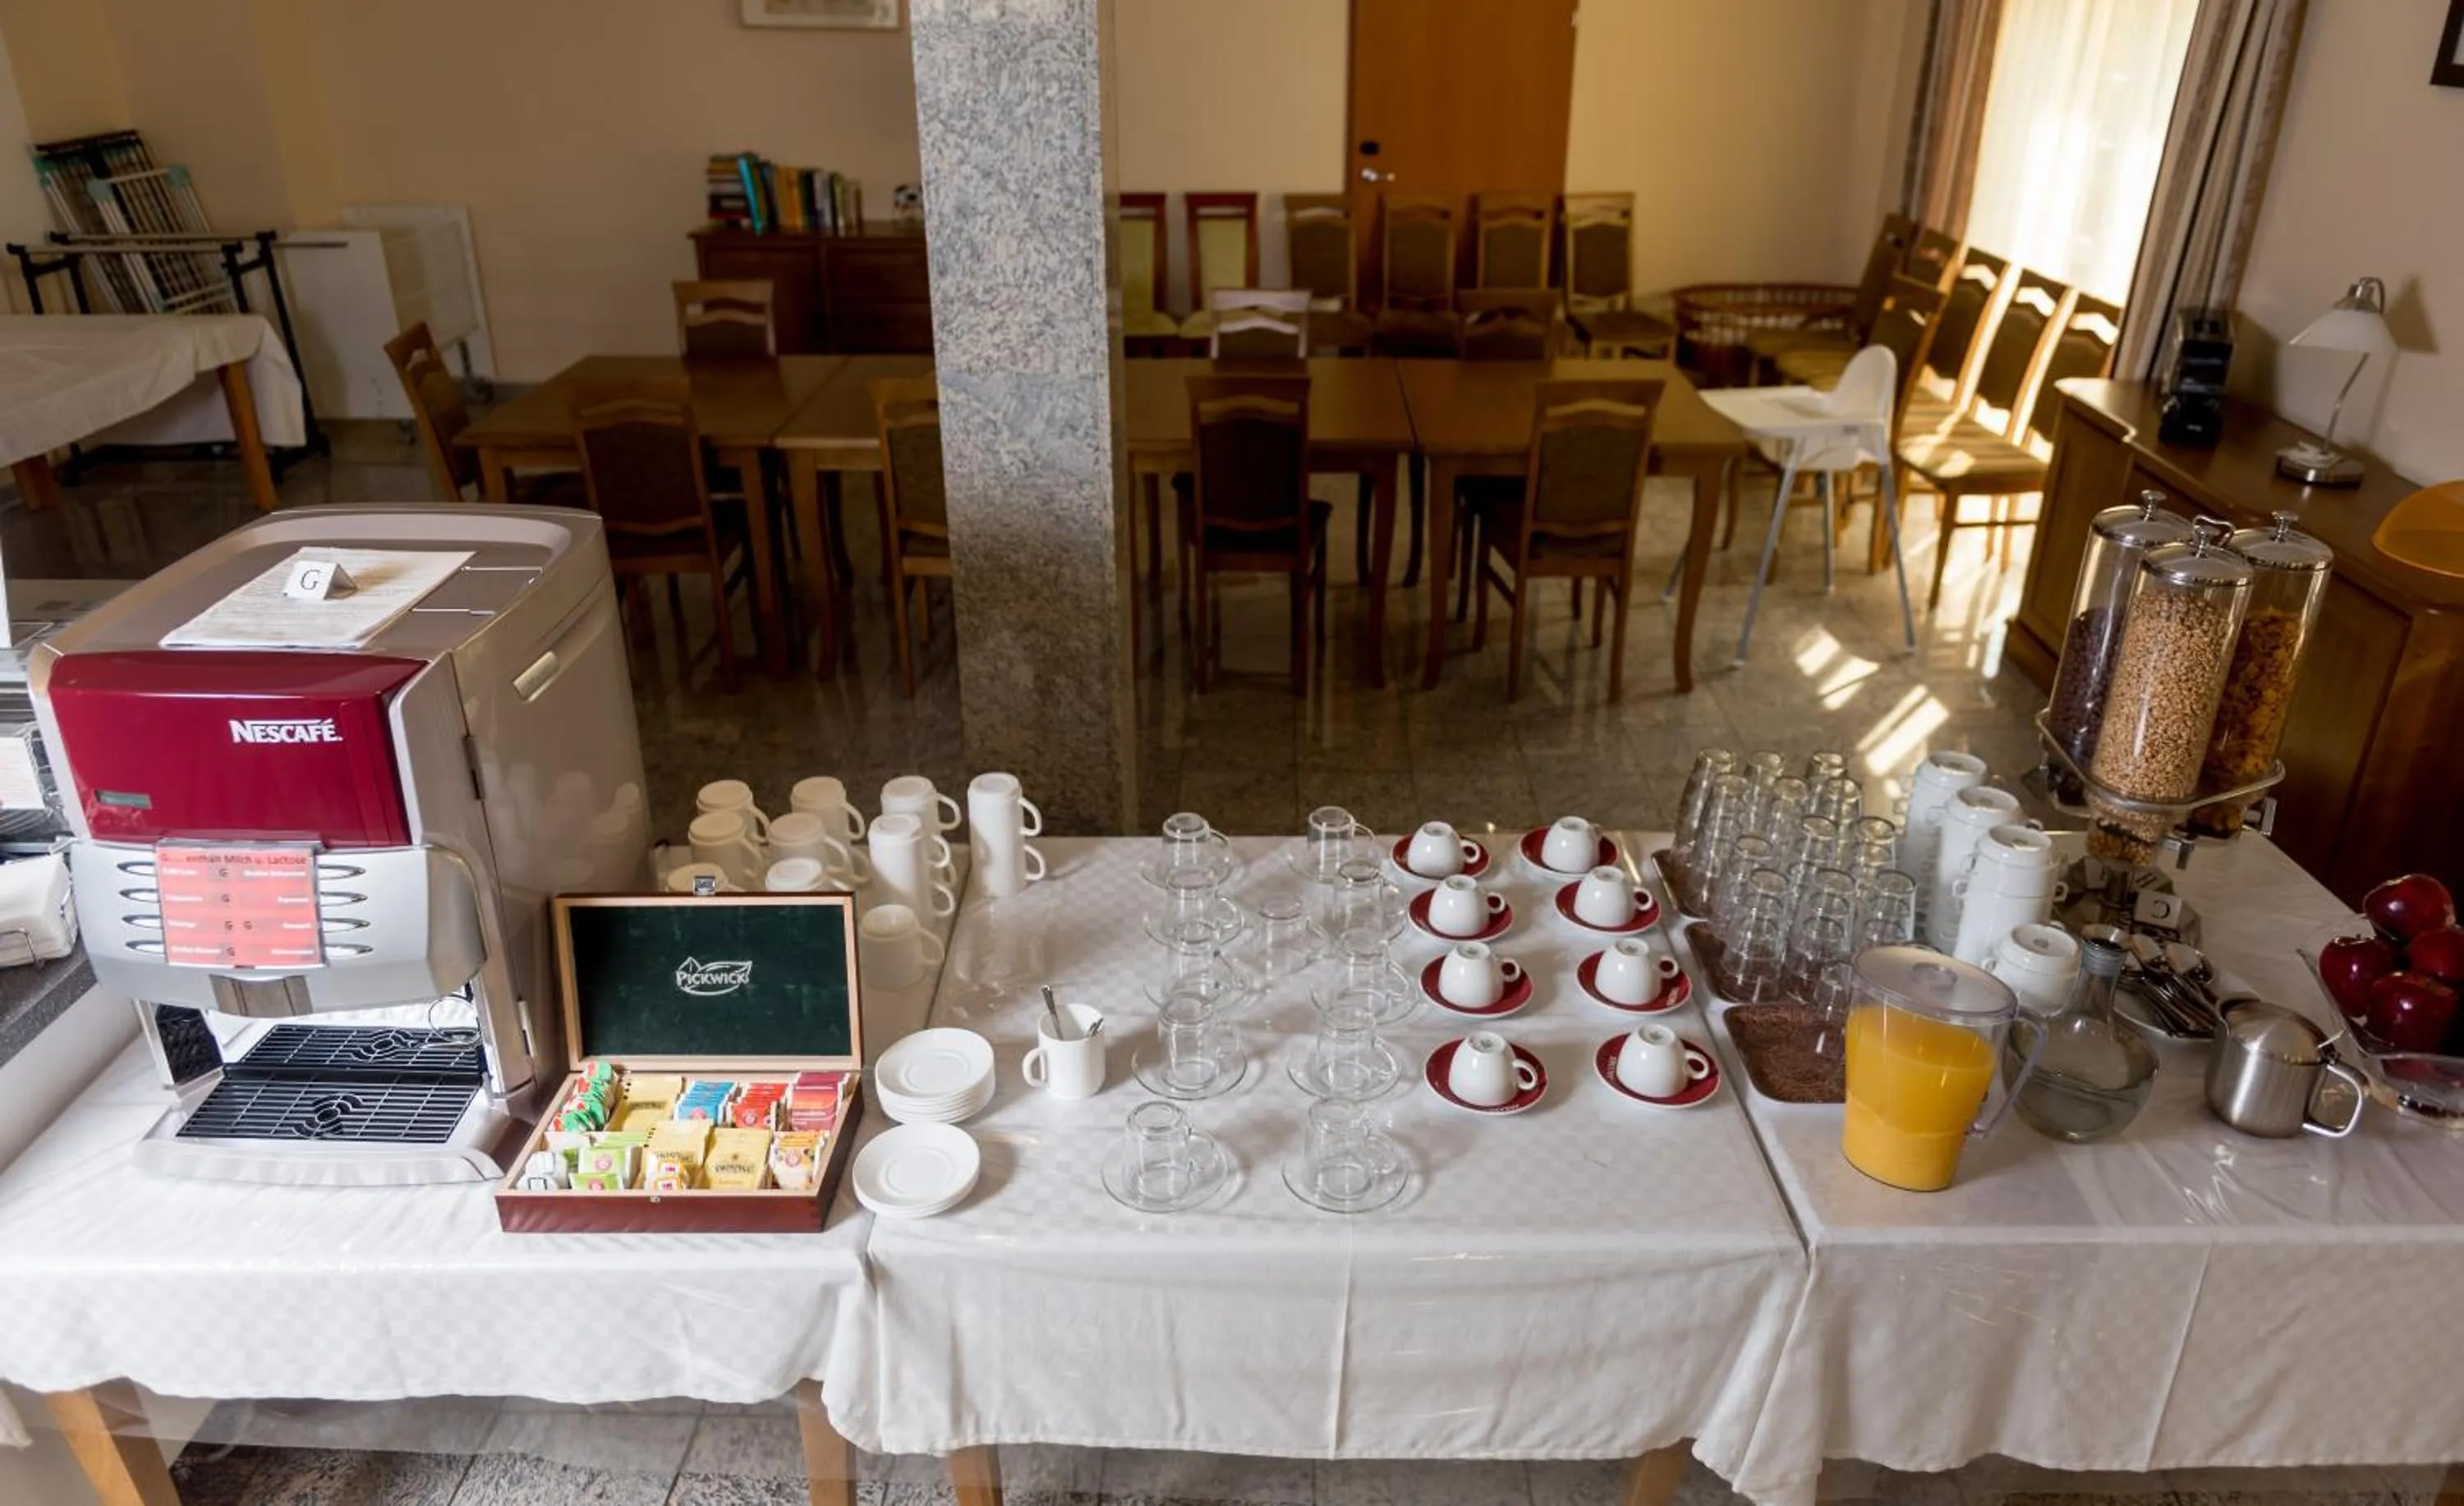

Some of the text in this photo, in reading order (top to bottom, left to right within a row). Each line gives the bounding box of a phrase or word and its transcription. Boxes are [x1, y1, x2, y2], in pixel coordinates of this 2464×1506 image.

[300, 569, 321, 590] G
[228, 719, 338, 743] NESCAFÉ
[675, 971, 750, 986] PICKWICK
